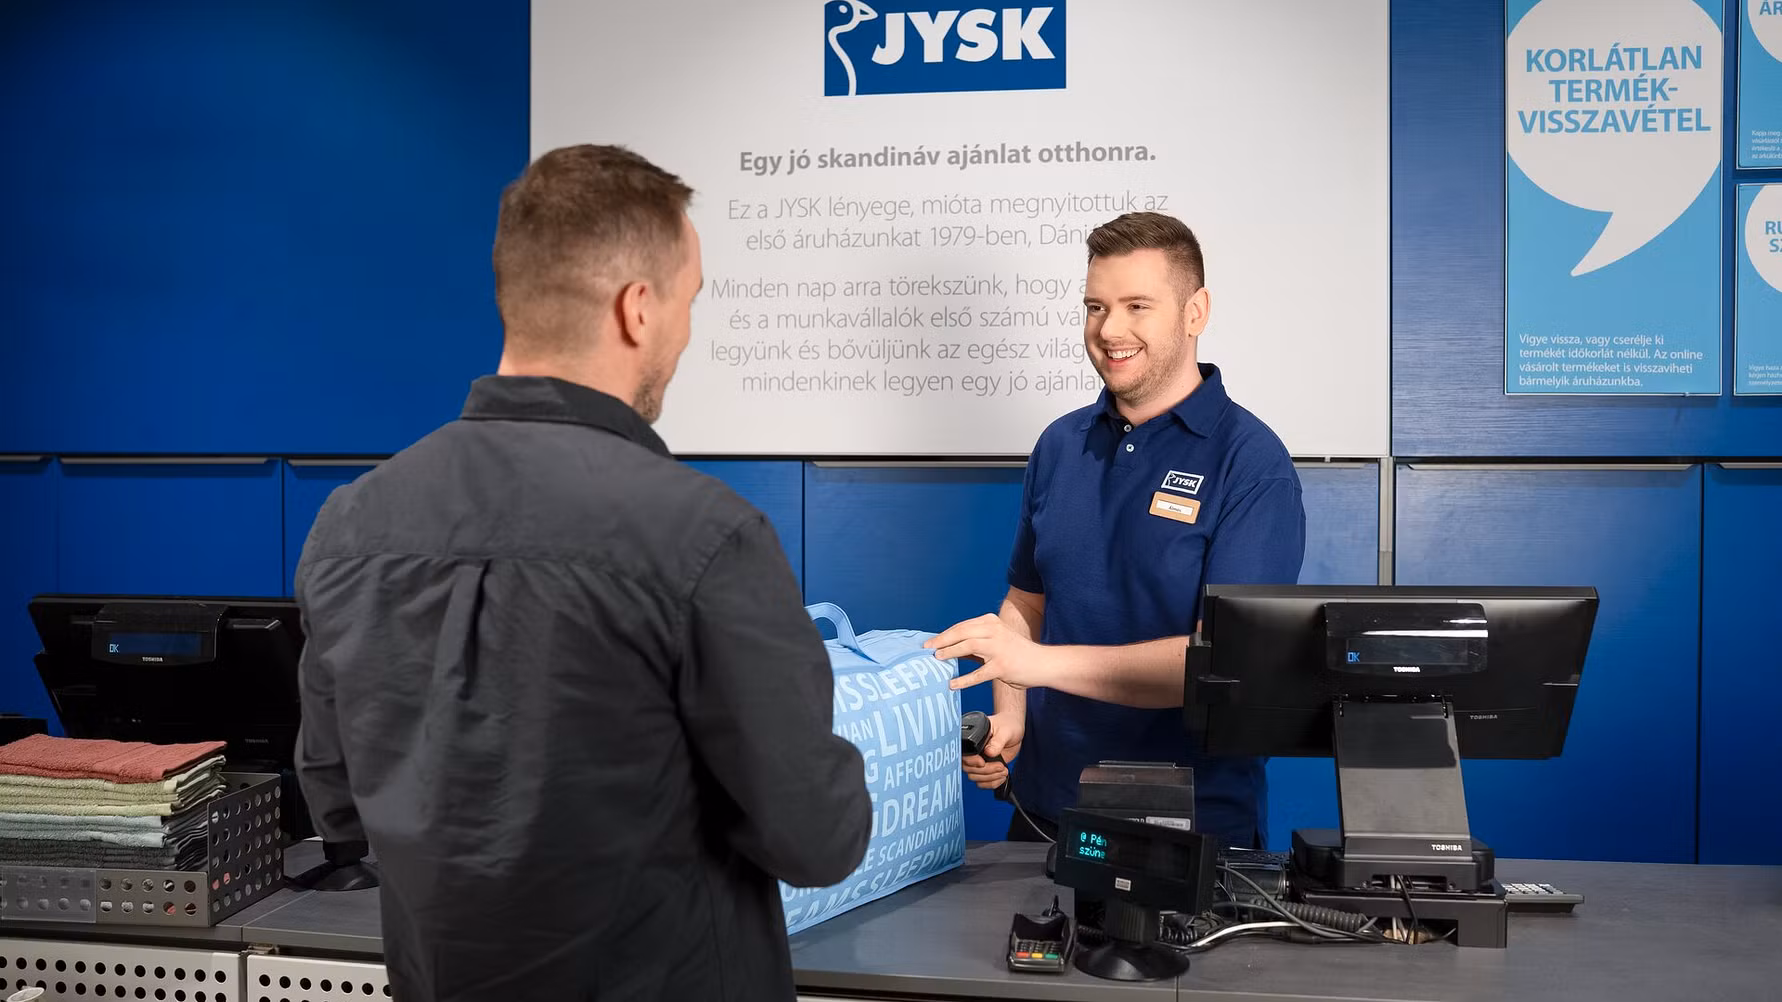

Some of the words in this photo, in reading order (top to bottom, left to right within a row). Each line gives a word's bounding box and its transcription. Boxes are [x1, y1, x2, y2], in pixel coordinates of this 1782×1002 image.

[871, 7, 1056, 65] JYSK
[1526, 42, 1702, 73] KORLÁTLAN
[1548, 73, 1678, 103] TERMÉK-
[1517, 104, 1711, 134] VISSZAVÉTEL
[740, 152, 782, 176] Egy
[787, 149, 811, 175] jó
[818, 146, 940, 168] skandináv
[947, 143, 1031, 170] ajánlat
[1038, 141, 1156, 163] otthonra.
[729, 199, 750, 219] Ez
[757, 203, 768, 218] a
[775, 197, 821, 218] JYSK
[829, 196, 914, 222] lényege,
[922, 194, 981, 214] mióta
[990, 190, 1137, 218] megnyitottuk
[1144, 194, 1168, 211] az
[746, 229, 786, 250] első
[793, 226, 921, 249] áruházunkat
[931, 224, 1031, 248] 1979-ben,
[1769, 238, 1782, 253] S
[711, 277, 789, 299] Minden
[797, 281, 836, 302] nap
[843, 280, 881, 297] arra
[889, 273, 1007, 298] törekszünk,
[1016, 273, 1072, 300] hogy
[729, 309, 751, 330] és
[757, 313, 769, 329] a
[777, 306, 926, 329] munkavállalók
[930, 306, 972, 328] első
[979, 306, 1049, 328] számú
[1056, 305, 1086, 326] vál
[711, 340, 792, 367] legyünk
[799, 340, 821, 360] és
[828, 337, 932, 365] bővüljünk
[937, 343, 961, 360] az
[967, 338, 1031, 365] egész
[1036, 337, 1086, 364] világ
[1519, 334, 1548, 347] Vigye
[1550, 334, 1583, 346] vissza,
[1585, 336, 1610, 347] vagy
[1613, 334, 1652, 347] cserélje
[1654, 335, 1664, 345] ki
[1519, 348, 1565, 359] termékét
[1568, 348, 1614, 359] időkorlát
[1617, 348, 1651, 360] nélkül.
[1653, 349, 1667, 360] Az
[1670, 350, 1704, 360] online
[742, 369, 877, 392] mindenkinek
[884, 368, 954, 397] legyen
[961, 374, 1002, 397] egy
[1006, 370, 1029, 397] jó
[1035, 368, 1104, 397] ajánlat
[1519, 362, 1560, 373] vásárolt
[1562, 362, 1621, 374] termékeket
[1623, 362, 1631, 373] is
[1633, 363, 1693, 374] visszaviheti
[1519, 375, 1570, 388] bármelyik
[1572, 376, 1643, 387] áruházunkba.
[1173, 477, 1197, 487] JYSK
[109, 643, 119, 653] OK
[1347, 652, 1360, 663] OK
[856, 656, 954, 701] SLEEPIN
[883, 736, 959, 792] AFFORDABL
[882, 769, 960, 839] DREAM
[877, 810, 960, 867] SCANDINAVIA
